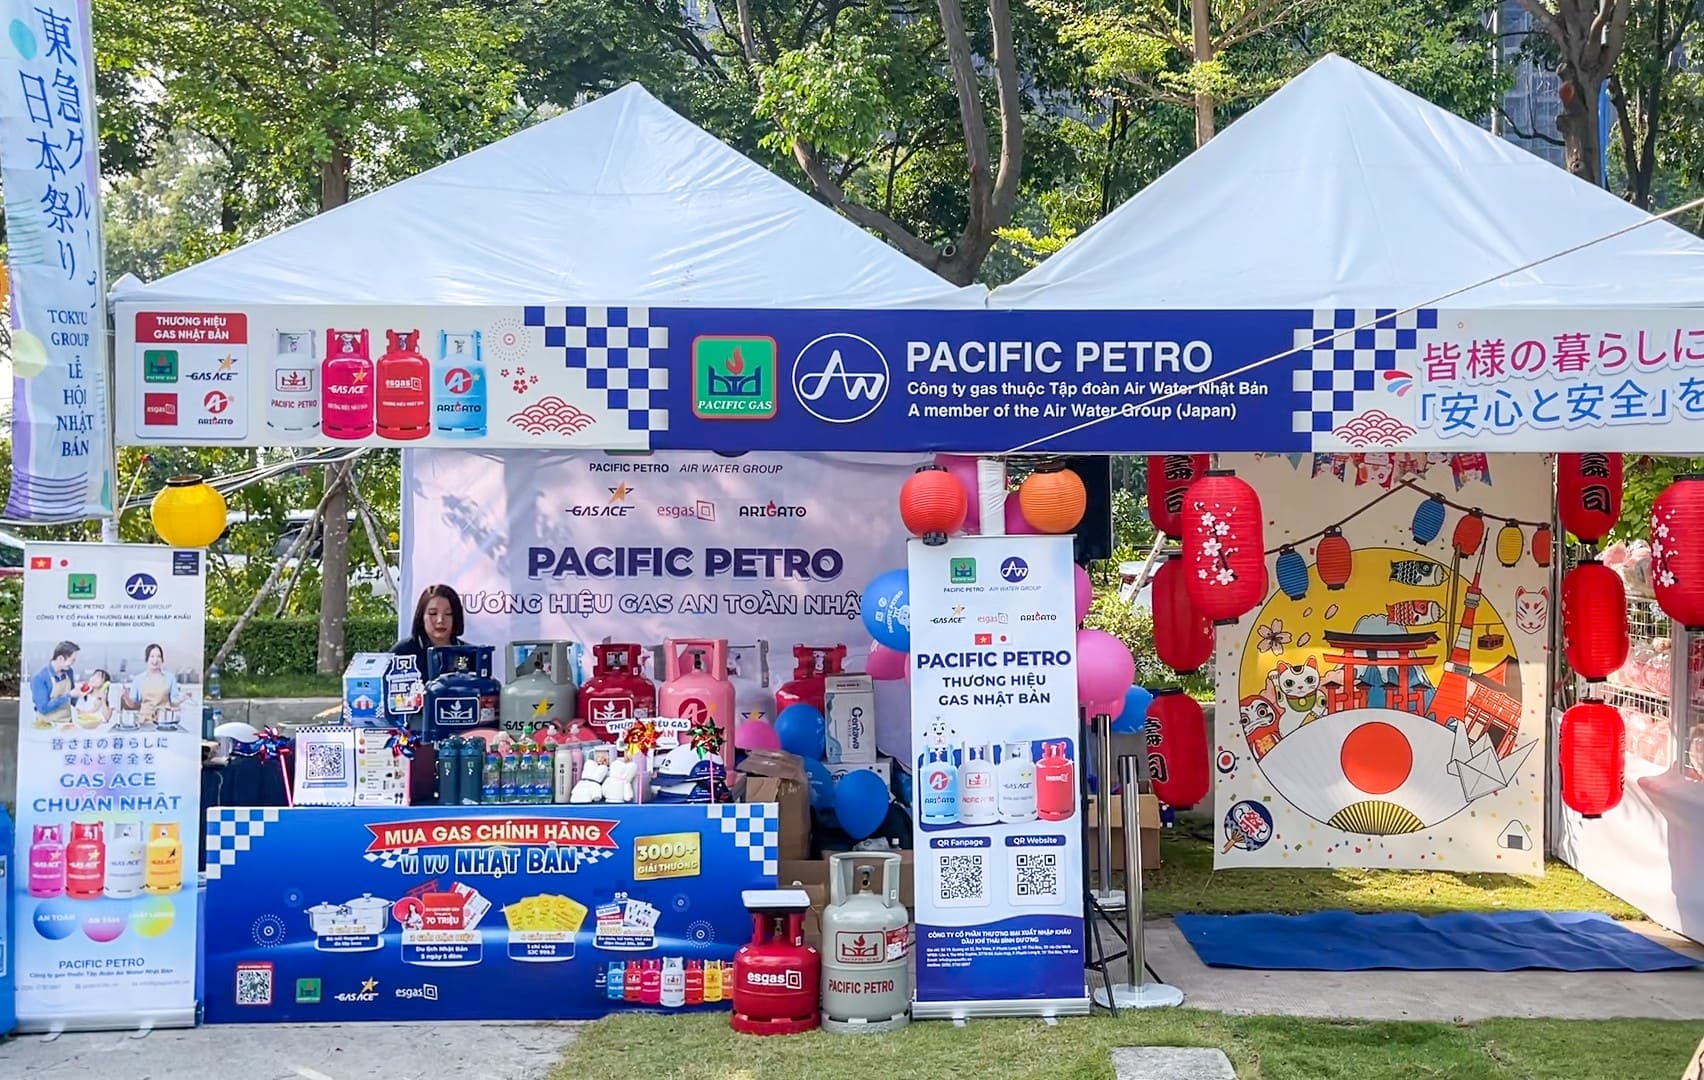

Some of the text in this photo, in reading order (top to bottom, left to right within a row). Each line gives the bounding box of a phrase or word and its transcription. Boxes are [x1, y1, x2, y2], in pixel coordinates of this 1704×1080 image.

[47, 309, 88, 325] TOKYU
[156, 315, 227, 328] THƯƠNG HIỆU
[51, 331, 89, 346] GROUP
[153, 329, 177, 340] GAS
[178, 329, 207, 342] NHẬT
[906, 341, 1213, 373] PACIFIC PETRO
[1423, 328, 1704, 382] 皆様の暮らしに
[907, 380, 1269, 398] Công ty gas thuộc Tập đoàn Air Water Nhật Bản
[437, 402, 482, 413] ARIGATO
[697, 400, 773, 410] PACIFIC GAS
[908, 403, 1237, 420] A member of the Air Water Group (Japan)
[589, 462, 669, 473] PACIFIC PETRO
[679, 463, 783, 474] AIR WATER GROUP
[566, 505, 635, 517] GAS ACE
[657, 505, 695, 519] esgas
[739, 501, 807, 518] ARIGATO
[528, 546, 844, 580] PACIFIC PETRO
[460, 588, 862, 620] ƯƠNG HIỆU GAS AN TOÀN NHẬ
[917, 649, 1072, 669] PACIFIC PETRO
[942, 672, 1046, 689] THƯƠNG HIỆU
[938, 694, 969, 706] GAS
[973, 691, 1014, 708] NHẬT
[504, 720, 524, 731] GAS
[671, 720, 688, 729] GAS
[52, 737, 168, 751] 皆さまの暮らしに
[64, 753, 155, 766] 安心と安全を
[60, 772, 157, 788] GAS ACE
[121, 792, 182, 815] NHẬT
[384, 827, 427, 846] MUA
[432, 825, 472, 842] GAS
[476, 820, 538, 840] CHÍNH
[937, 838, 984, 848] QR Fanpage
[1013, 836, 1058, 845] QR Website
[637, 841, 697, 862] 3000+
[401, 853, 419, 874] VI
[424, 854, 449, 874] VU
[455, 844, 522, 879] NHẬT
[59, 957, 145, 970] PACIFIC PETRO
[747, 971, 785, 985] esgas
[395, 987, 423, 999] esgas
[828, 979, 895, 995] PACIFIC PETRO
[336, 992, 375, 1001] GAS ACE
